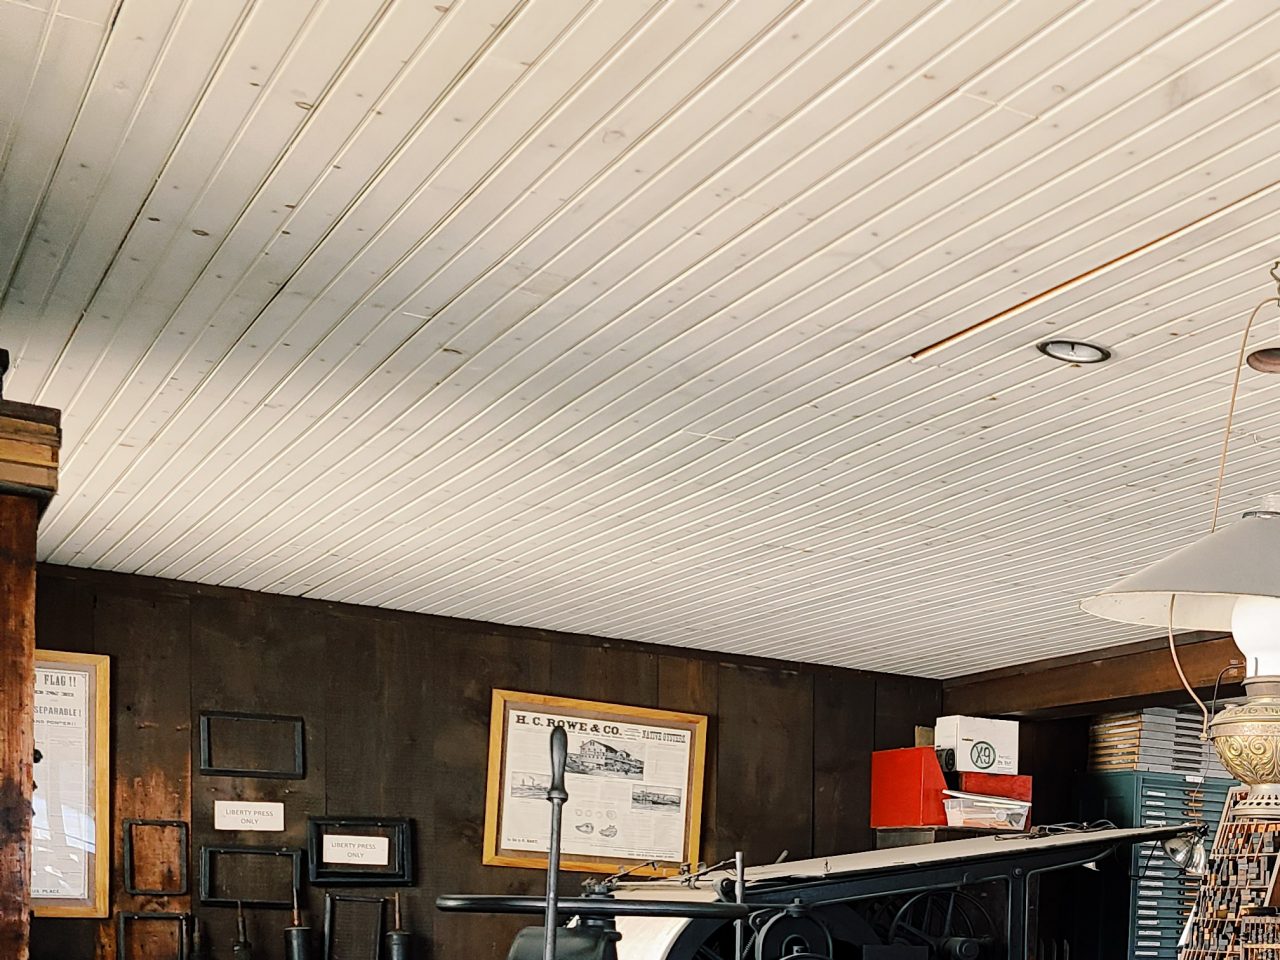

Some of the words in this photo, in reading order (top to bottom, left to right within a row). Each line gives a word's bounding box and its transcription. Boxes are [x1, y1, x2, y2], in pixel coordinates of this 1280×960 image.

[515, 714, 529, 725] H.
[532, 716, 544, 726] C.
[546, 718, 588, 732] ROWE
[590, 723, 601, 733] &
[603, 725, 623, 736] CO.
[225, 808, 252, 816] LIBERTY
